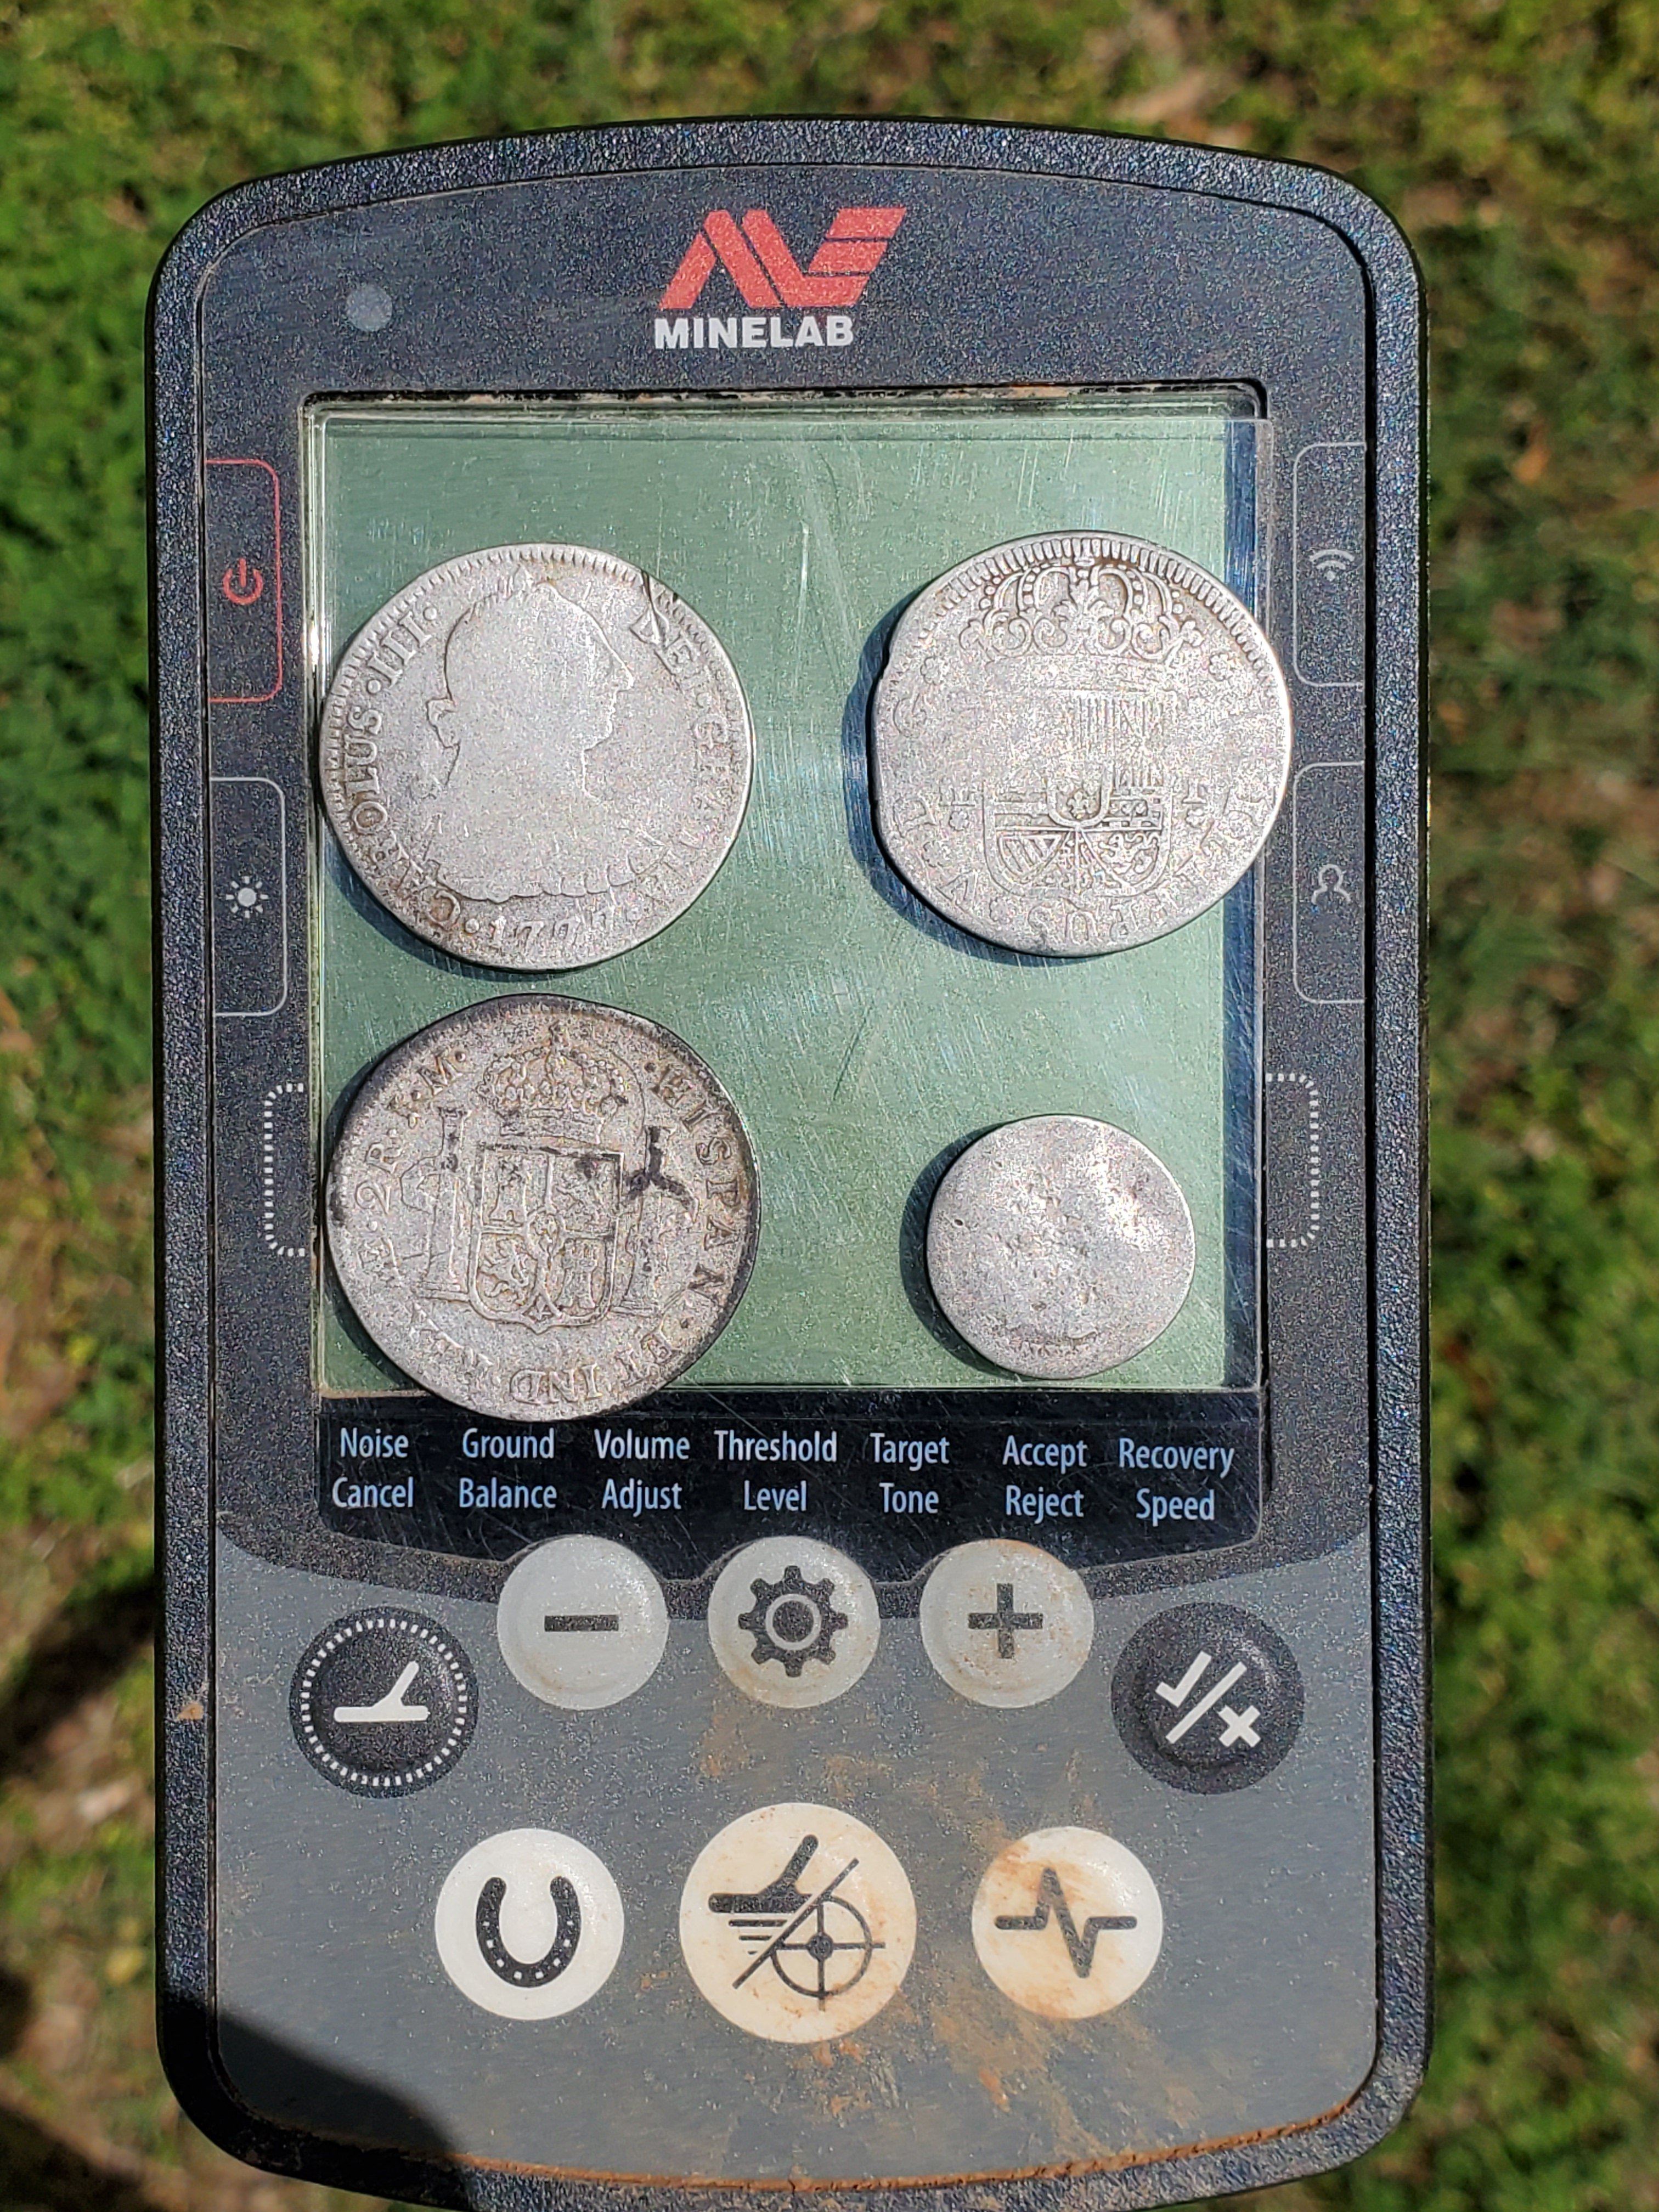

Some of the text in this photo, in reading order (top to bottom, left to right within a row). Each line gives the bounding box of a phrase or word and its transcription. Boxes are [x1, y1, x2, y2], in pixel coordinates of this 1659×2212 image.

[654, 315, 854, 349] MINELAB
[341, 1427, 408, 1457] Noise
[463, 1428, 554, 1458] Ground
[595, 1429, 690, 1459] Volume
[714, 1430, 837, 1462] Threshold
[870, 1433, 949, 1471] Target
[1003, 1436, 1087, 1474] Accept
[1120, 1438, 1234, 1477] Recovery
[332, 1477, 413, 1508] Cancel
[460, 1478, 556, 1508] Balance
[602, 1479, 682, 1516] Adjust
[744, 1481, 806, 1511] Level
[879, 1483, 938, 1513] Tone
[1007, 1486, 1083, 1523] Reject
[1137, 1489, 1214, 1526] Speed
